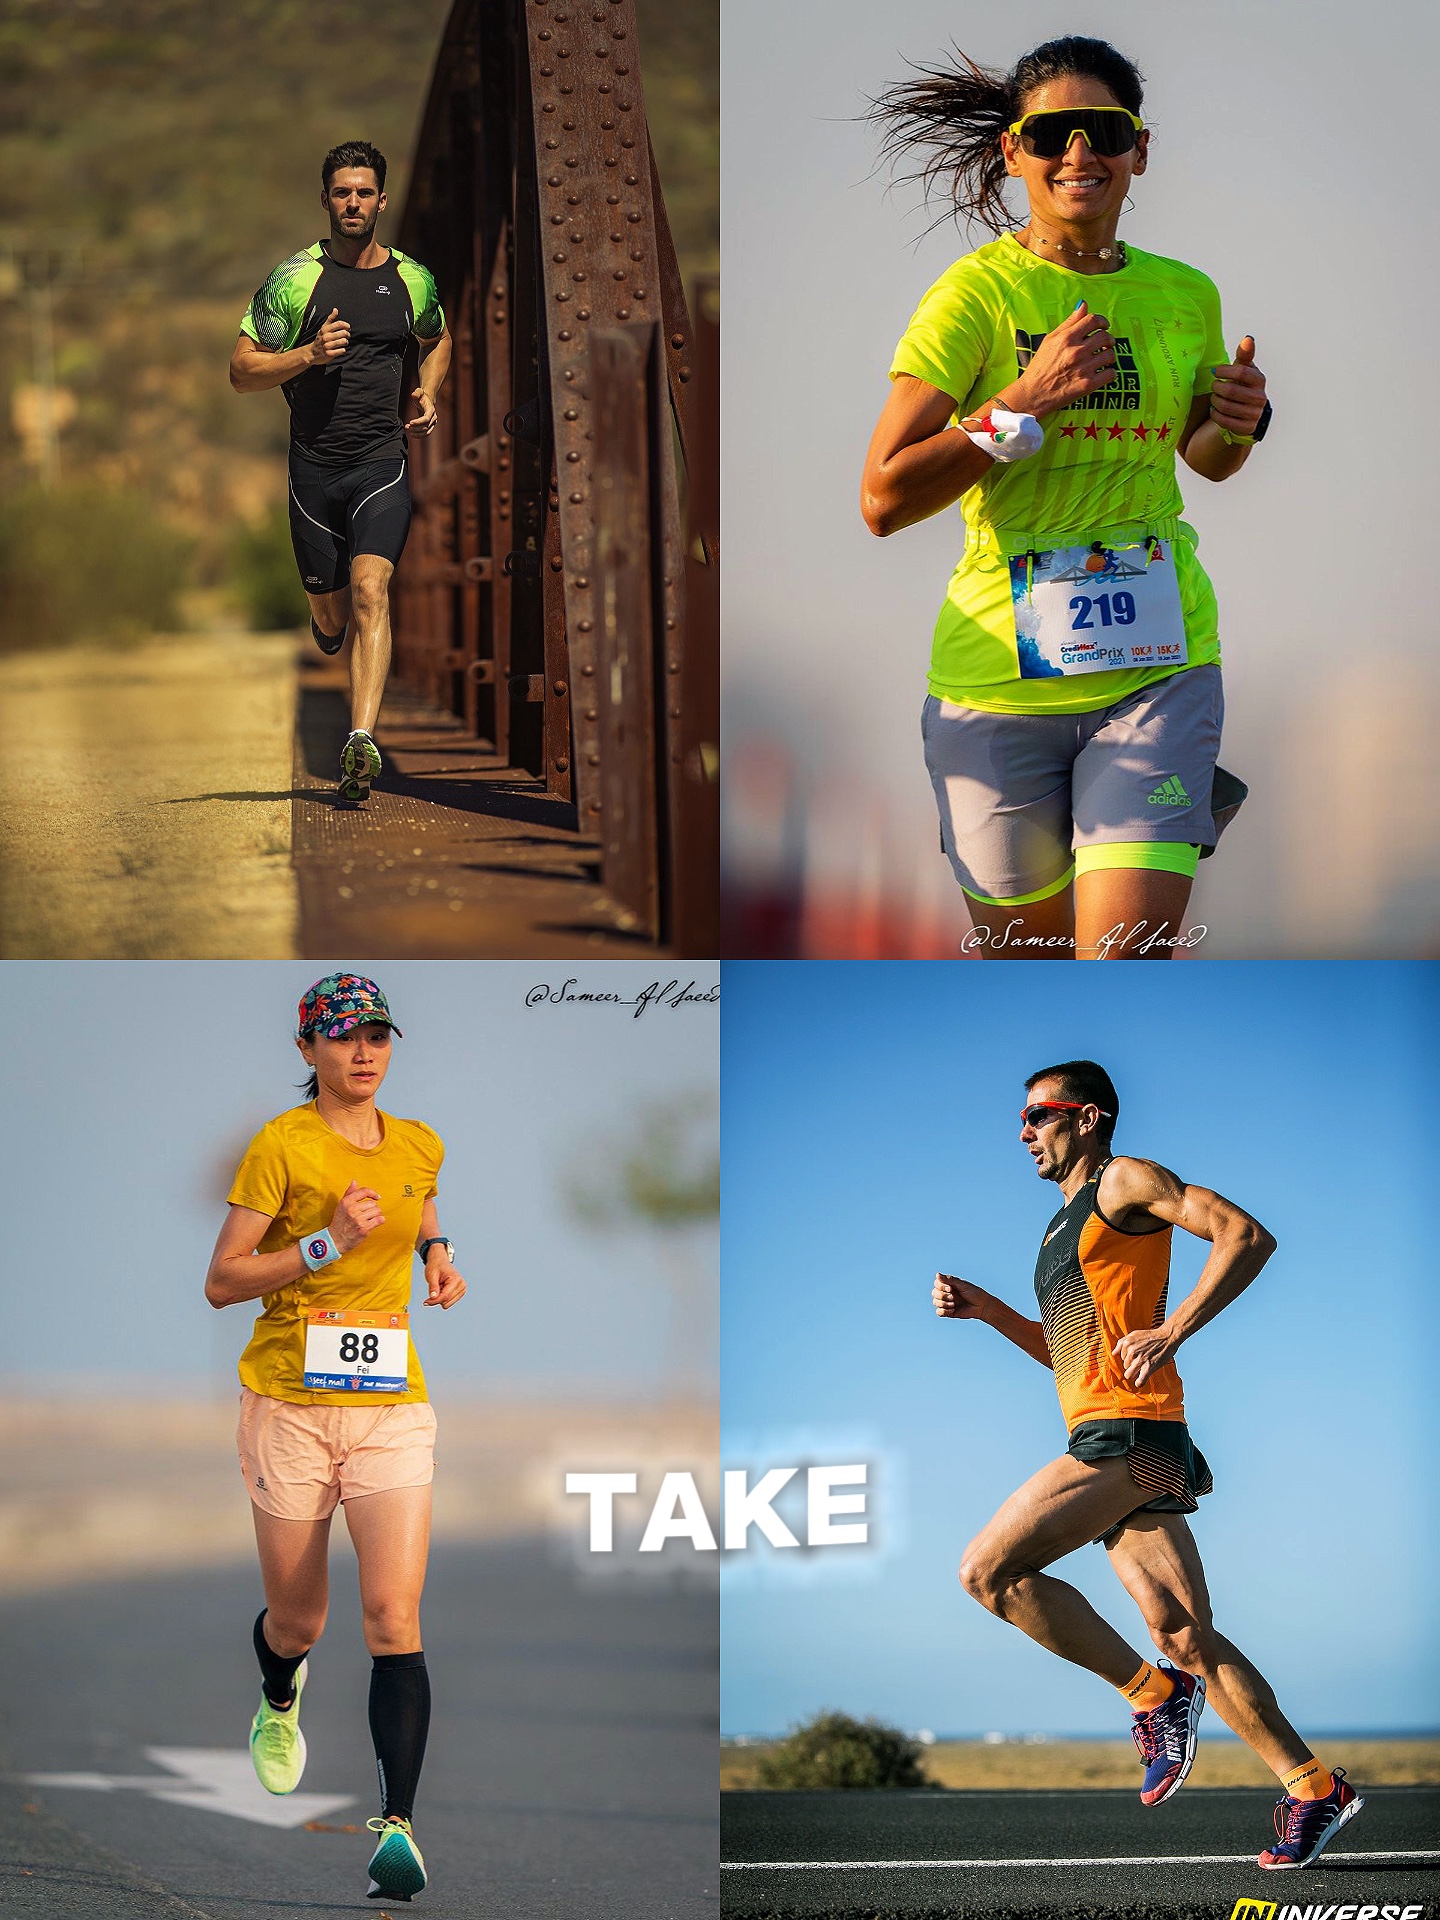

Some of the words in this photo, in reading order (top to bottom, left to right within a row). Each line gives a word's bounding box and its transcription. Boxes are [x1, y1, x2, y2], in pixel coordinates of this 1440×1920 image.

[1155, 330, 1176, 366] AROUND
[1169, 368, 1180, 388] RUN
[1074, 397, 1137, 410] HING
[1069, 591, 1136, 630] 219
[1061, 647, 1124, 664] GrandPrix
[1131, 645, 1145, 656] 10K
[1157, 644, 1172, 655] 15K
[1109, 657, 1126, 666] 2021
[1147, 793, 1191, 807] adidas
[339, 1332, 379, 1363] 88
[356, 1365, 370, 1374] Fei
